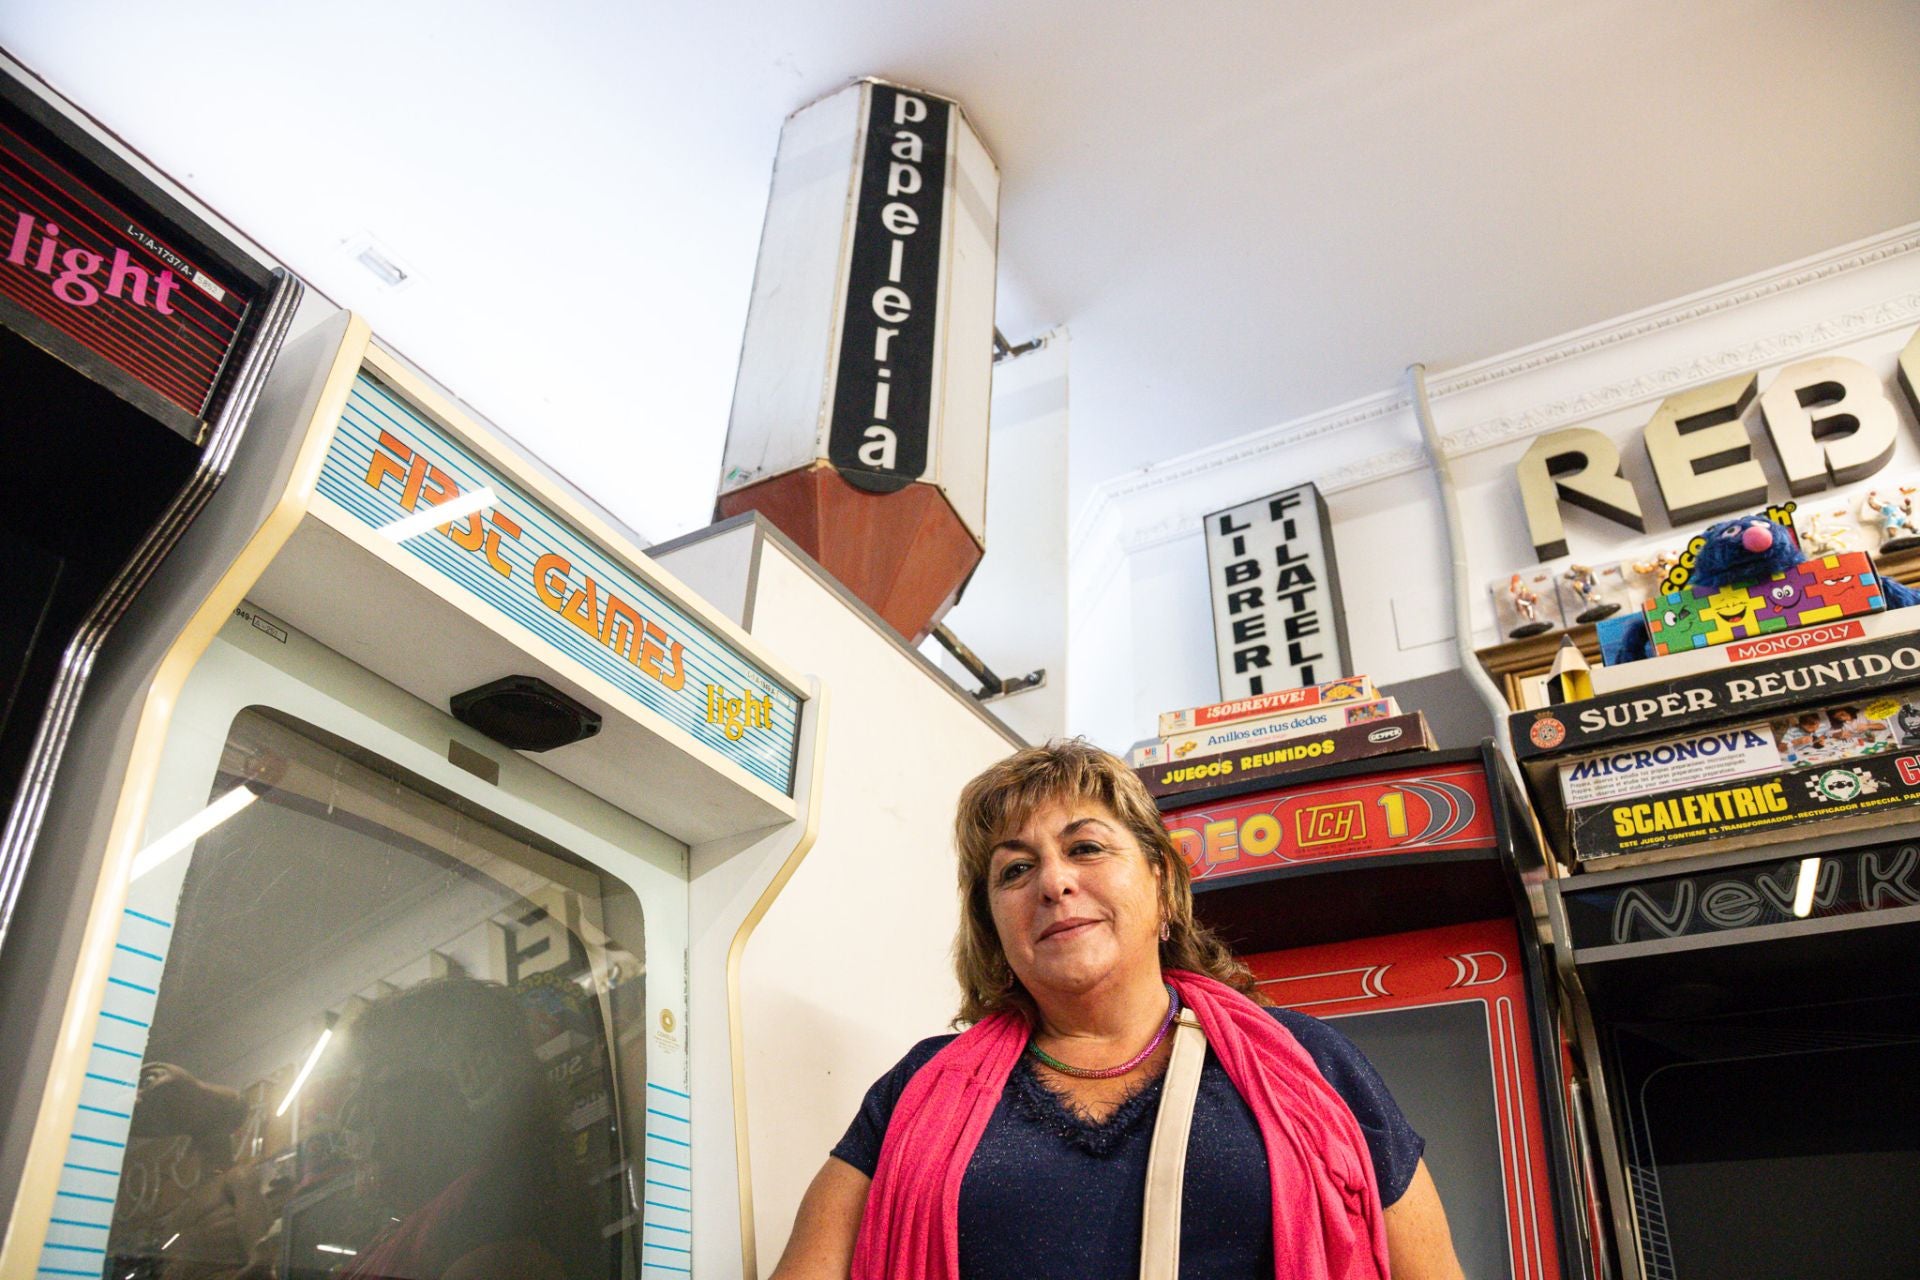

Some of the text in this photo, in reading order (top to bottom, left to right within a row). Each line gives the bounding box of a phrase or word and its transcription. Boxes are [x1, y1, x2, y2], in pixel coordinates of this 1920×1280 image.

[6, 212, 180, 315] light
[858, 94, 927, 469] papeleria
[1516, 325, 1920, 563] REB
[533, 553, 686, 692] GAMES
[1738, 625, 1850, 659] MONOPOLY
[706, 684, 773, 741] light
[1207, 690, 1306, 719] ¡SOBREVIVE!
[1208, 728, 1250, 746] Anillos
[1252, 727, 1268, 738] en
[1269, 723, 1289, 734] tus
[1290, 713, 1328, 729] dedos
[1579, 688, 1717, 734] SUPER
[1161, 739, 1335, 785] JUEGOS REUNIDOS
[1569, 729, 1768, 782] MICRONOVA
[1306, 807, 1354, 840] TCH
[1377, 792, 1409, 839] 1
[1612, 782, 1788, 838] SCALEXTRIC
[1619, 839, 1638, 849] ESTE
[1640, 836, 1666, 847] JUEGO
[1667, 829, 1707, 841] CONTIENE
[1709, 826, 1720, 835] EL
[1860, 795, 1902, 808] ESPECIAL
[1612, 857, 1842, 944] New
